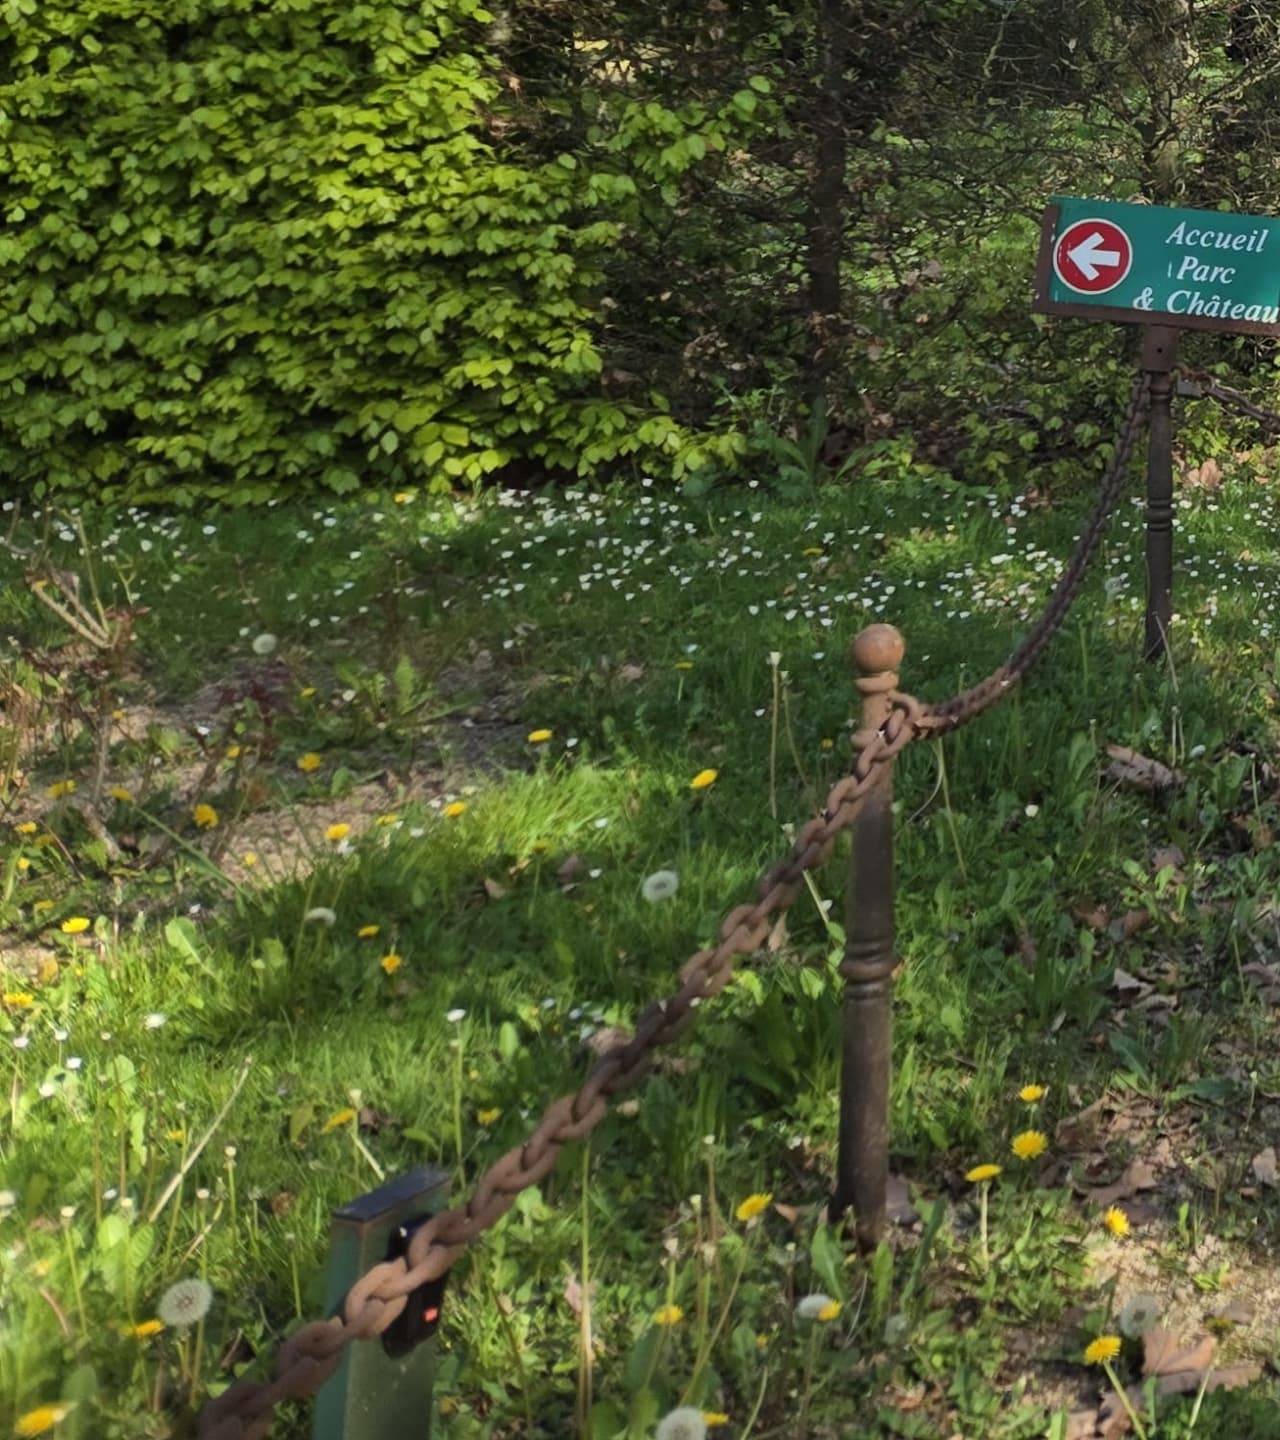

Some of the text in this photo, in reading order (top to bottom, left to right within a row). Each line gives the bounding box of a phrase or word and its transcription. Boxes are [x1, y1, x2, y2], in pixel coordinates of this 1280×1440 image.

[1165, 221, 1269, 252] Accueil
[1176, 255, 1236, 283] Parc
[1132, 286, 1279, 323] & Château
